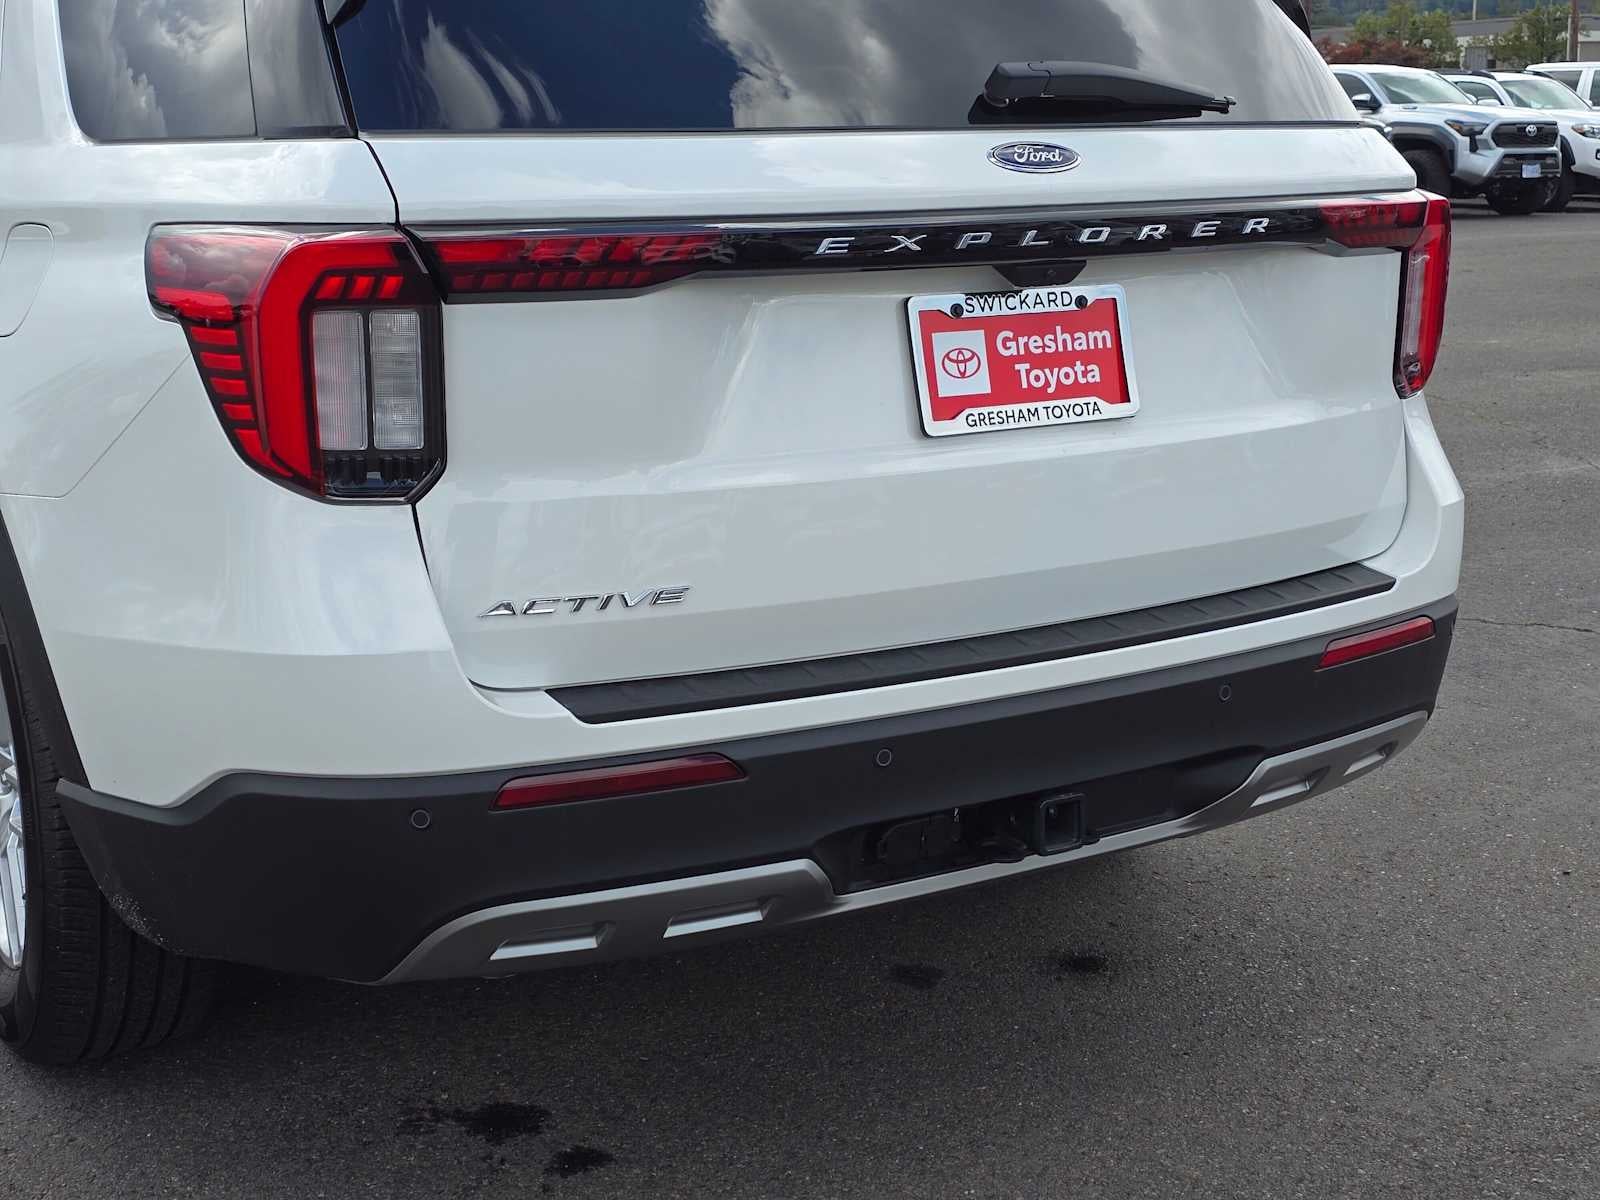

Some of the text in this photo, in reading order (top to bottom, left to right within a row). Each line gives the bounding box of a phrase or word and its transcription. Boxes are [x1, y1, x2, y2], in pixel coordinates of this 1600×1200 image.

[1014, 145, 1062, 162] Ford
[815, 217, 1270, 255] EXPLORER
[965, 291, 1073, 313] SWICKARD
[996, 325, 1112, 357] Gresham
[1014, 360, 1100, 393] Toyota
[965, 401, 1102, 429] GRESHAM TOYOTA
[478, 586, 690, 617] ACTIVE
